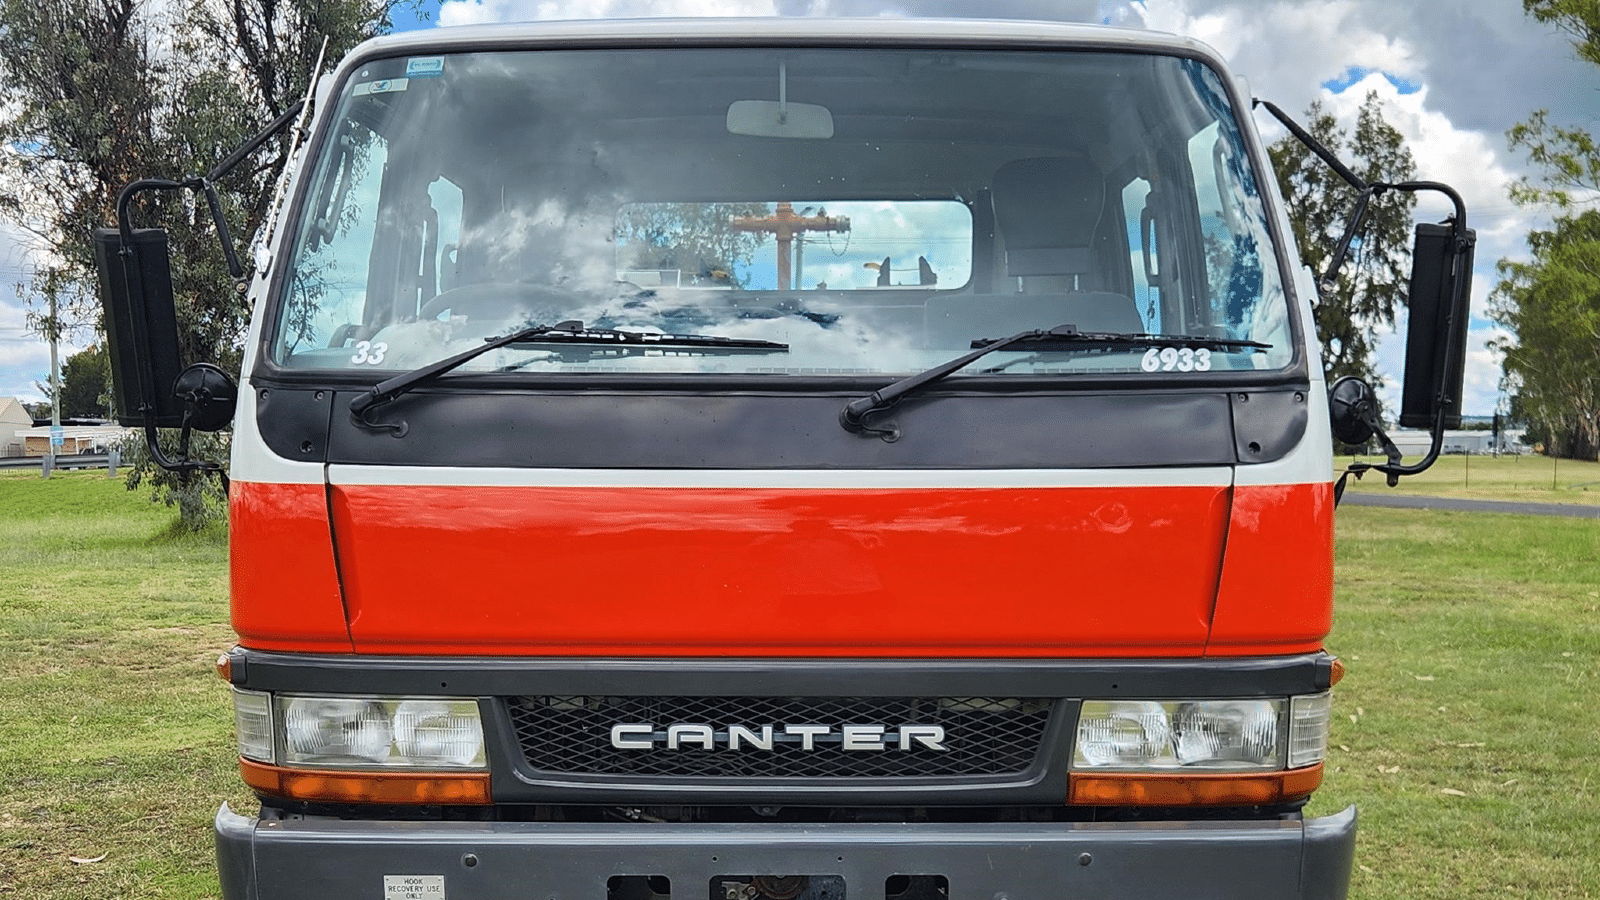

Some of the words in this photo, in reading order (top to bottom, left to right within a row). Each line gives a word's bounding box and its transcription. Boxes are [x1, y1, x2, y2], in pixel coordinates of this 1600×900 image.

[351, 340, 388, 365] 33
[1141, 347, 1211, 372] 6933
[610, 723, 951, 751] CANTER
